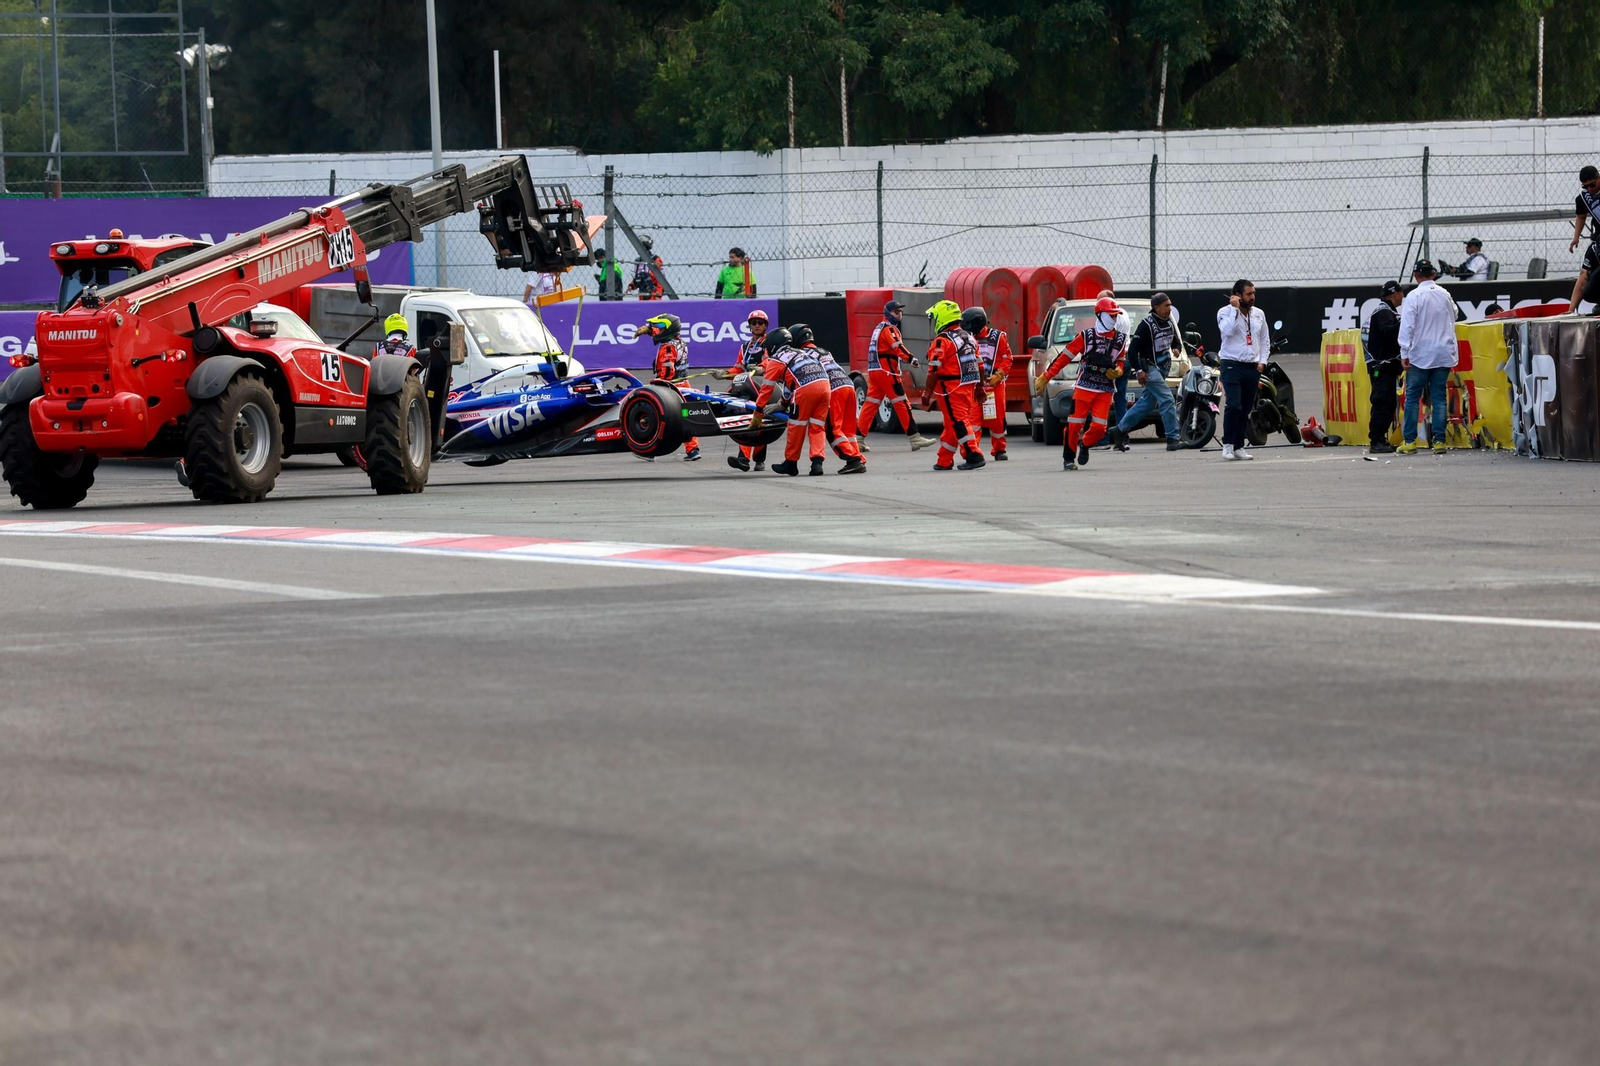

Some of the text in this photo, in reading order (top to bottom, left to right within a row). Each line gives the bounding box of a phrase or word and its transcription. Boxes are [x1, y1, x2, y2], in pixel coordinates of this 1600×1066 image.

[257, 236, 324, 285] MANITOU
[48, 329, 97, 341] MANITOU
[572, 325, 639, 346] LAS
[321, 353, 340, 381] 15
[487, 401, 546, 439] VISA
